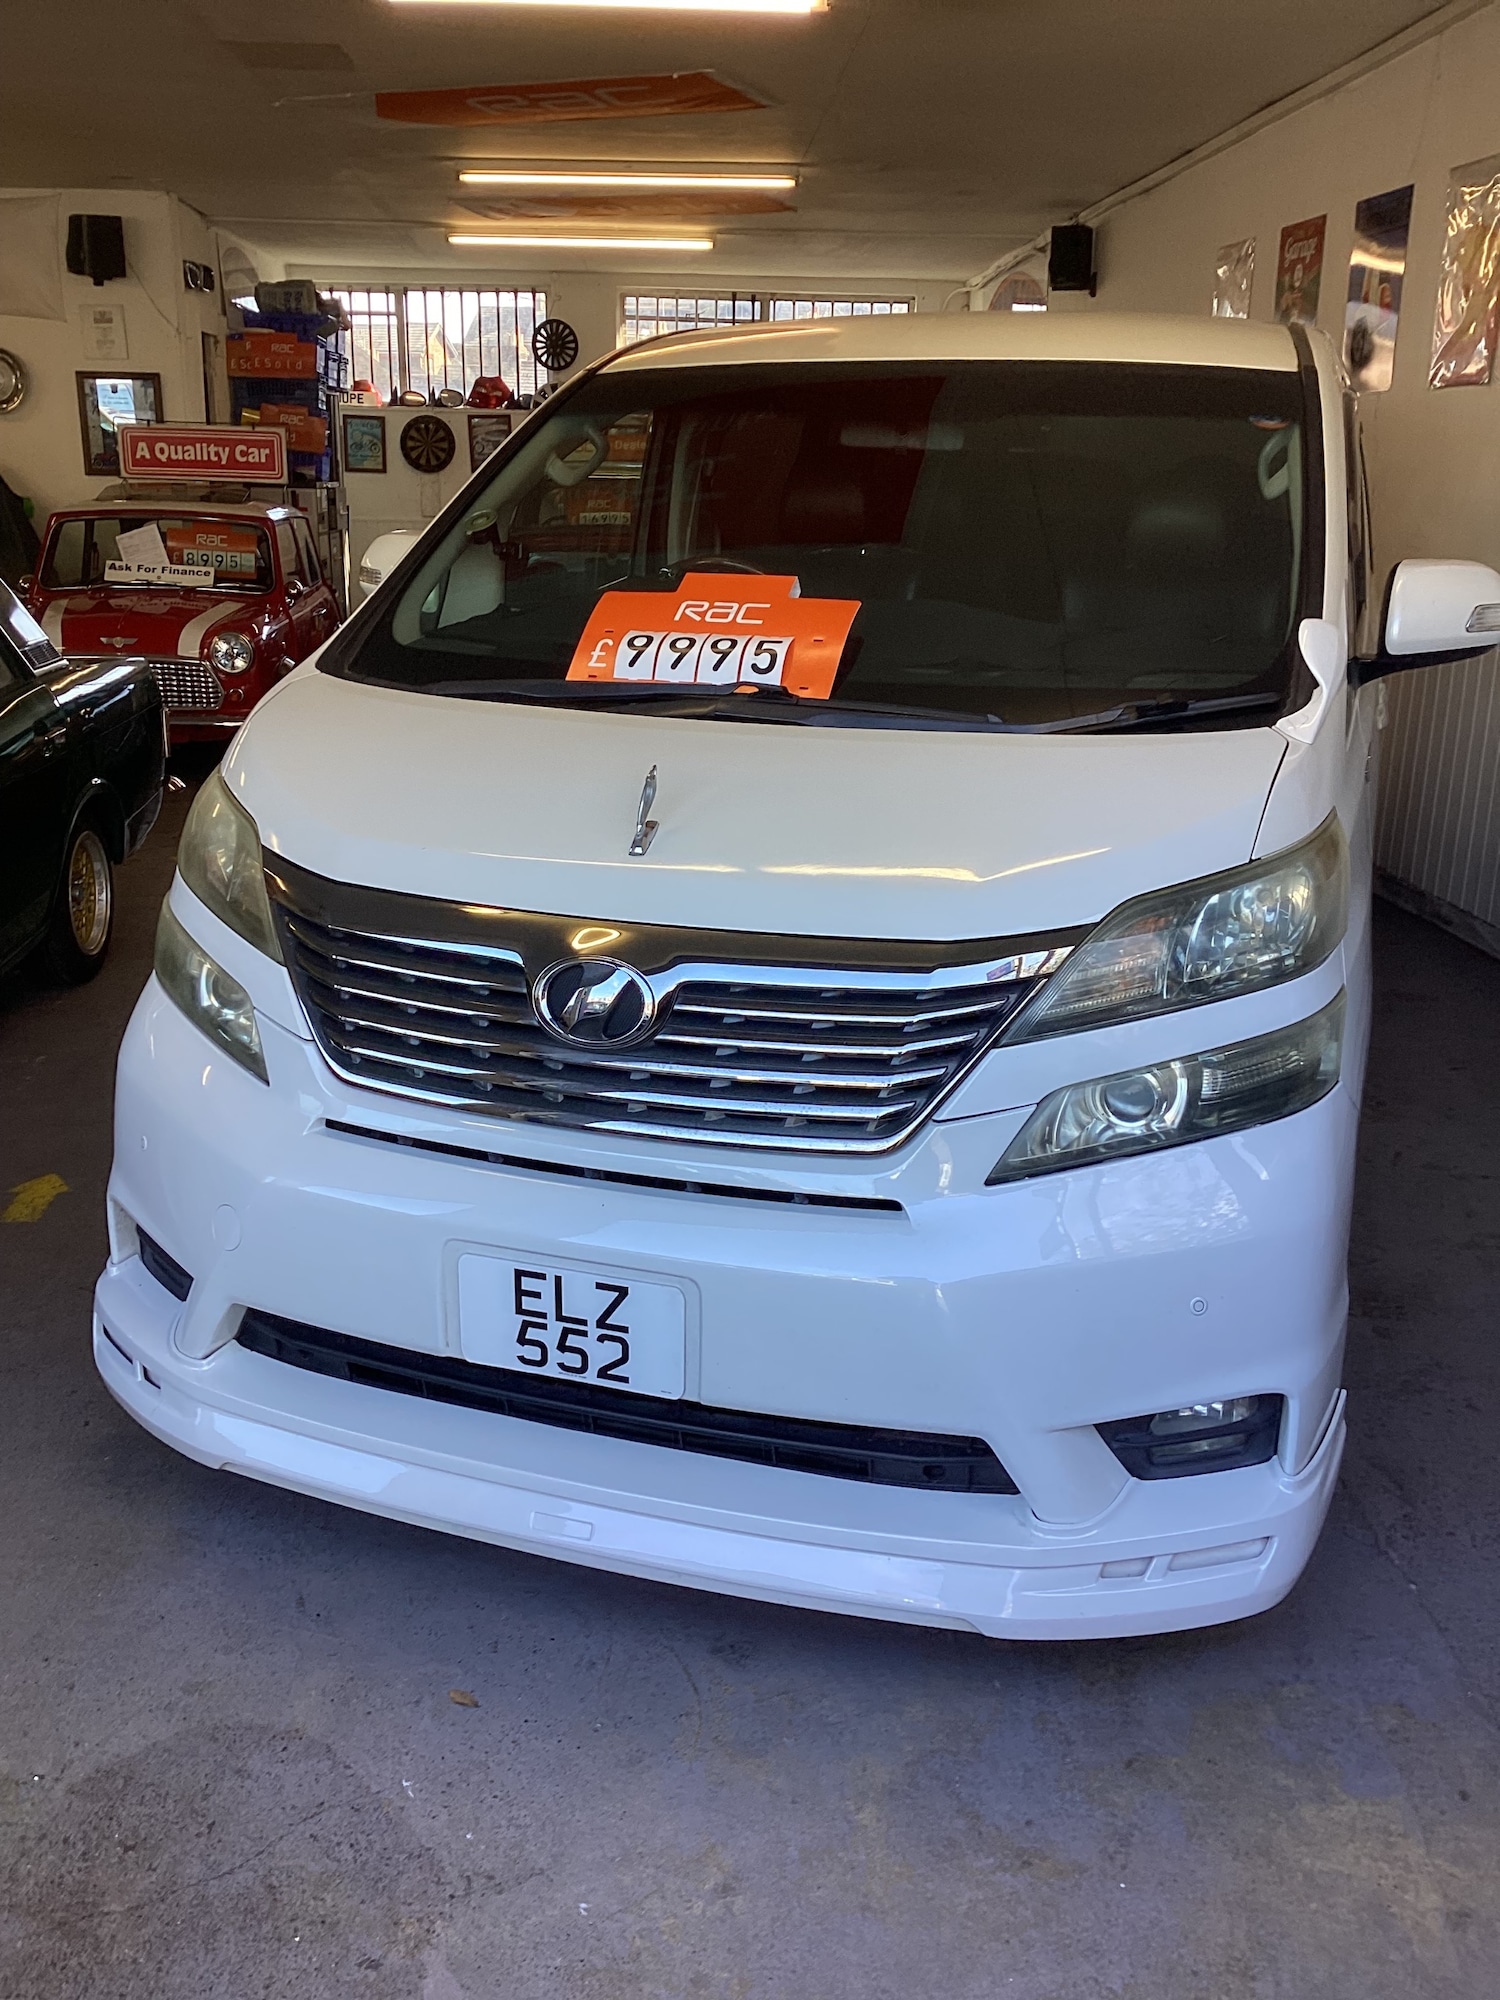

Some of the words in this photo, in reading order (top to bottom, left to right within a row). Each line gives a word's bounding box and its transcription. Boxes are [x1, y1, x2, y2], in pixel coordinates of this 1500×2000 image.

[135, 441, 151, 460] A
[154, 442, 230, 465] Quality
[235, 445, 270, 463] Car
[614, 440, 646, 450] Deale
[108, 562, 132, 572] Ask
[136, 565, 157, 574] For
[161, 566, 211, 577] Finance
[514, 1267, 630, 1334] ELZ
[515, 1319, 630, 1384] 552
